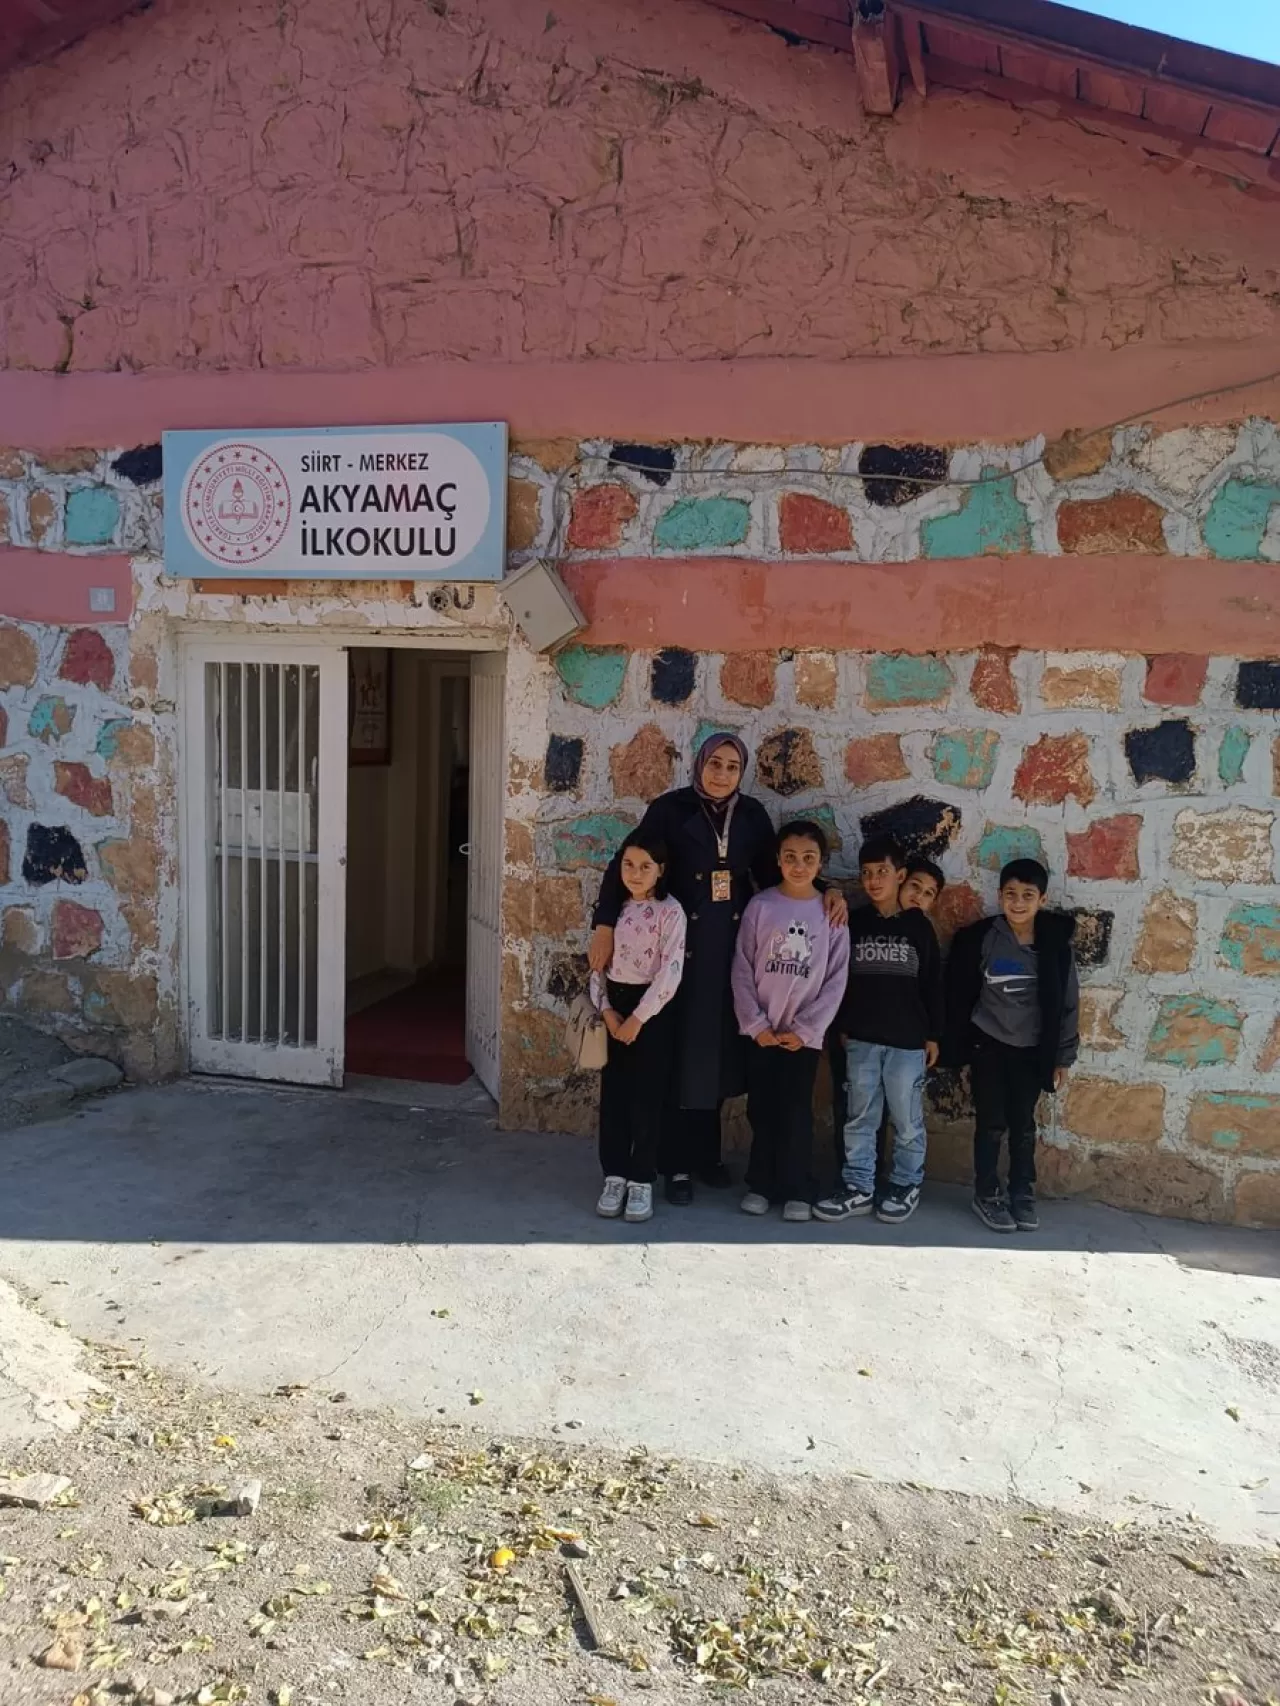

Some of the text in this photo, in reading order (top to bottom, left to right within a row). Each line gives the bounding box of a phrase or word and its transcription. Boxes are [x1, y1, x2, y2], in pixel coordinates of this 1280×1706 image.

[301, 450, 342, 473] SİİRT
[359, 453, 430, 472] MERKEZ
[300, 482, 457, 521] AKYAMAÇ
[301, 520, 456, 556] İLKOKULU
[856, 947, 909, 962] JONES
